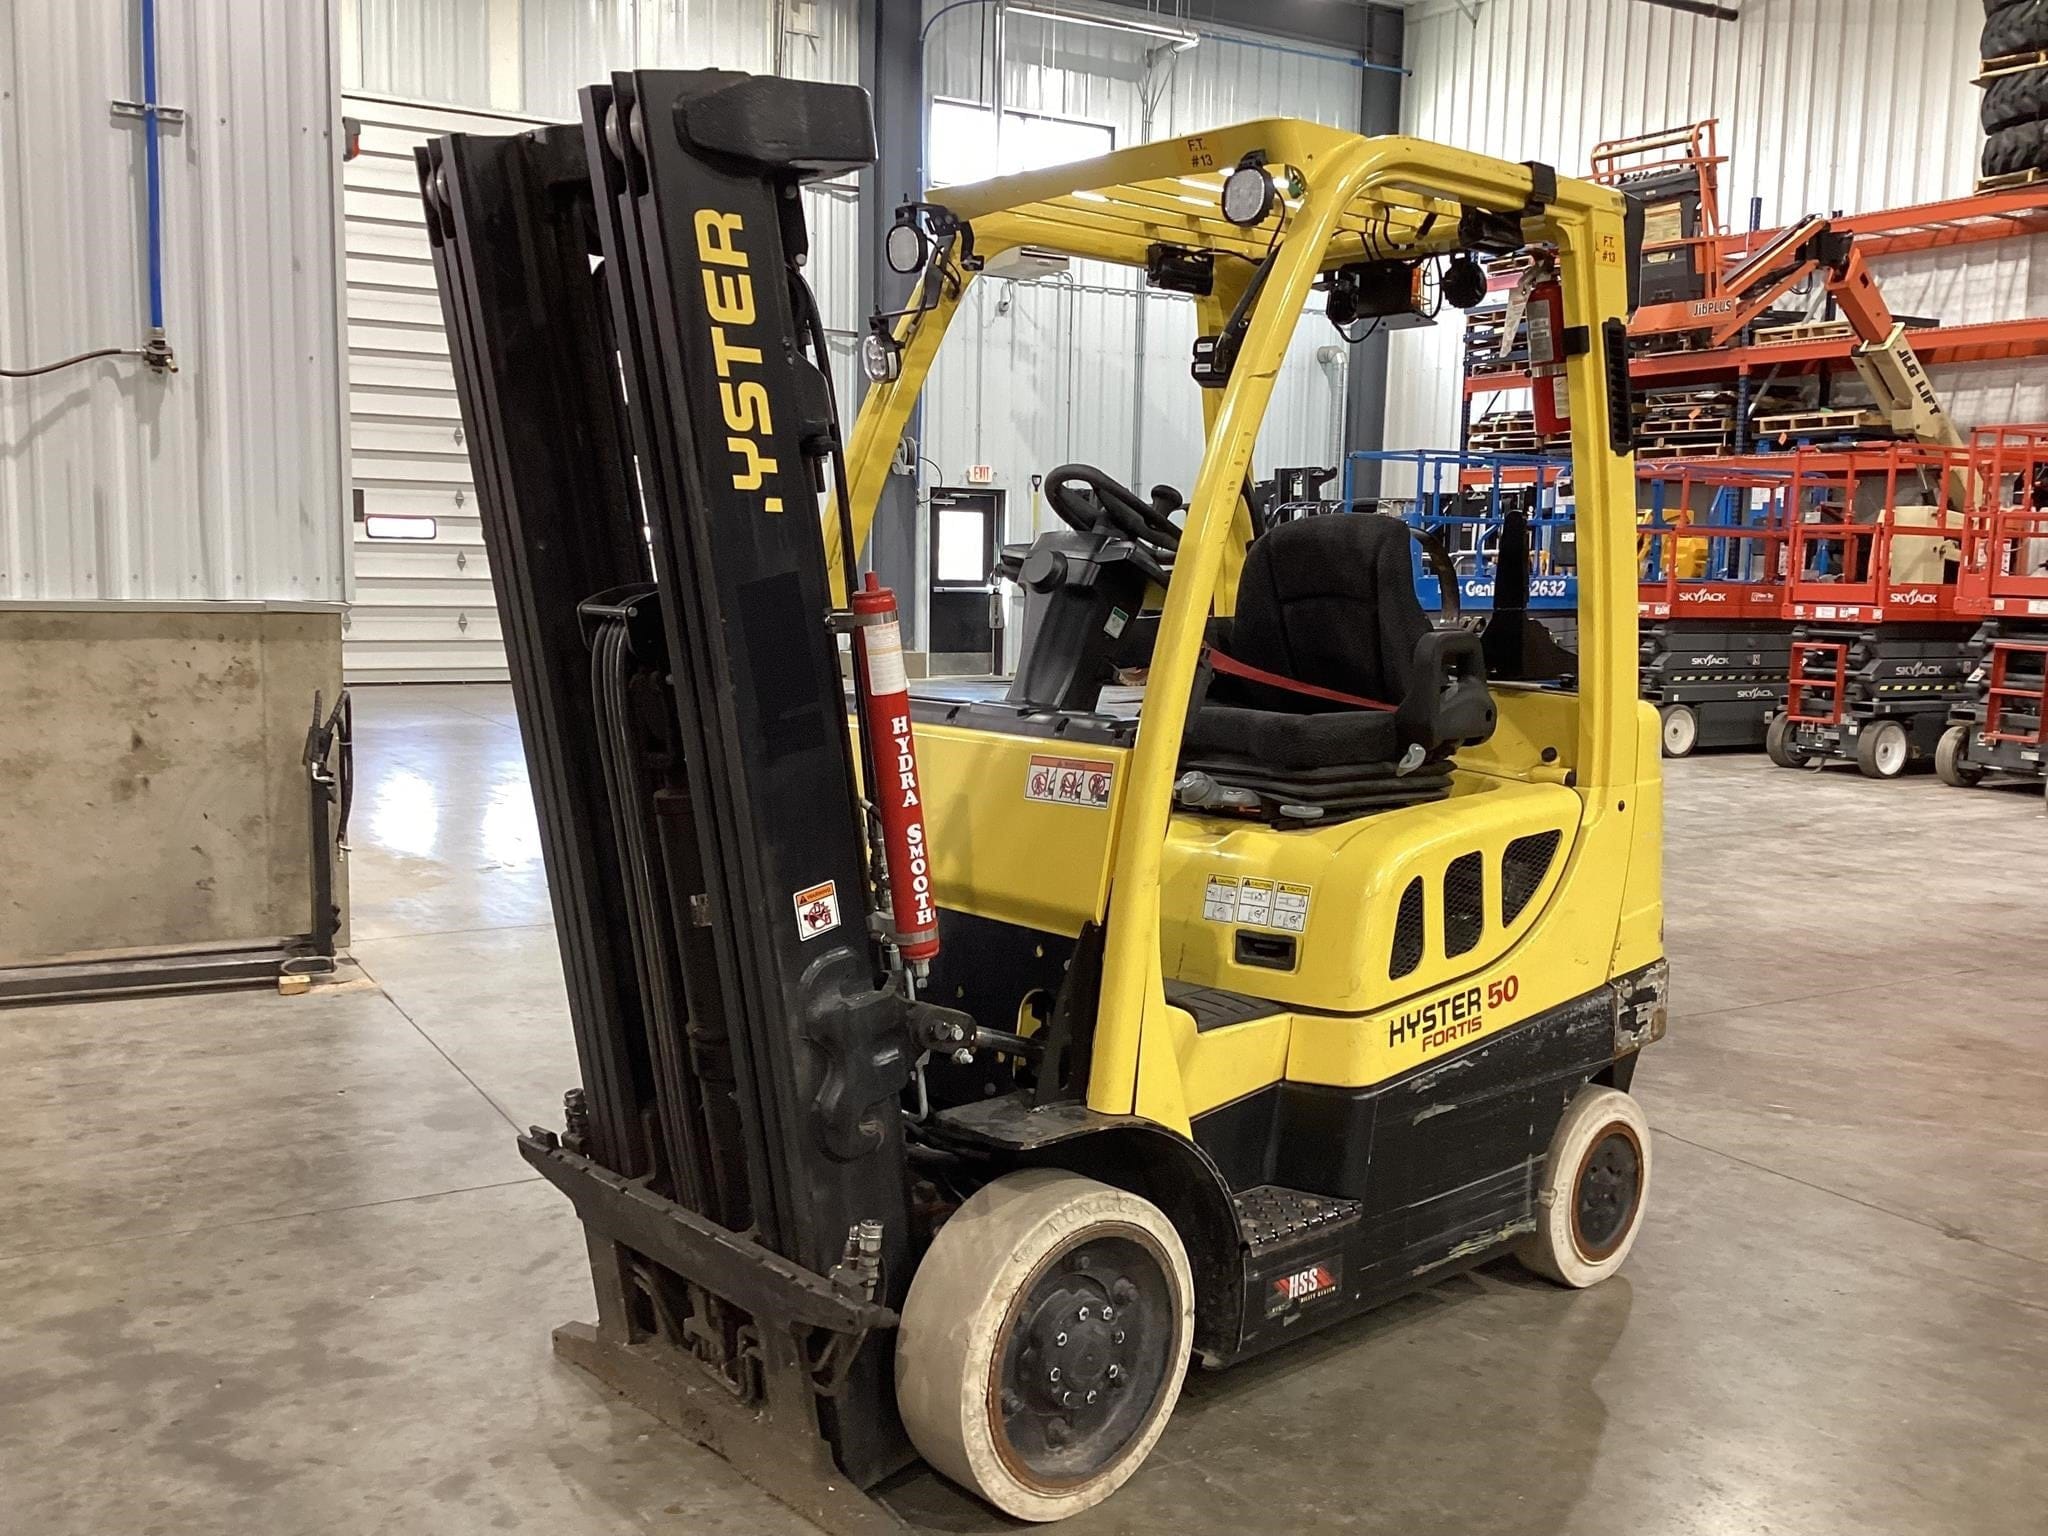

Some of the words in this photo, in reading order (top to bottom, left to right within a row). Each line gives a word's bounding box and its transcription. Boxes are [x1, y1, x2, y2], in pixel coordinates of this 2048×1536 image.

[1192, 154, 1213, 168] #13
[1602, 250, 1616, 263] #13
[694, 209, 784, 513] YSTER
[1896, 350, 1920, 378] JLG
[1915, 380, 1941, 415] LIFT
[974, 466, 989, 481] EXIT
[1465, 580, 1495, 597] Geni
[1679, 588, 1727, 603] SKYJACK
[1890, 589, 1937, 605] SKYJACK
[1691, 654, 1729, 666] SKYJACK
[1896, 661, 1941, 677] SKYJACK
[1737, 687, 1774, 699] SKYJACK
[891, 715, 919, 808] HYDRA
[906, 823, 933, 925] SMOOTH
[1286, 886, 1308, 894] CAUTION
[1390, 987, 1481, 1048] HYSTER
[1488, 975, 1519, 1009] 50
[1422, 1016, 1482, 1052] FORTIS
[1289, 1268, 1318, 1300] HSS
